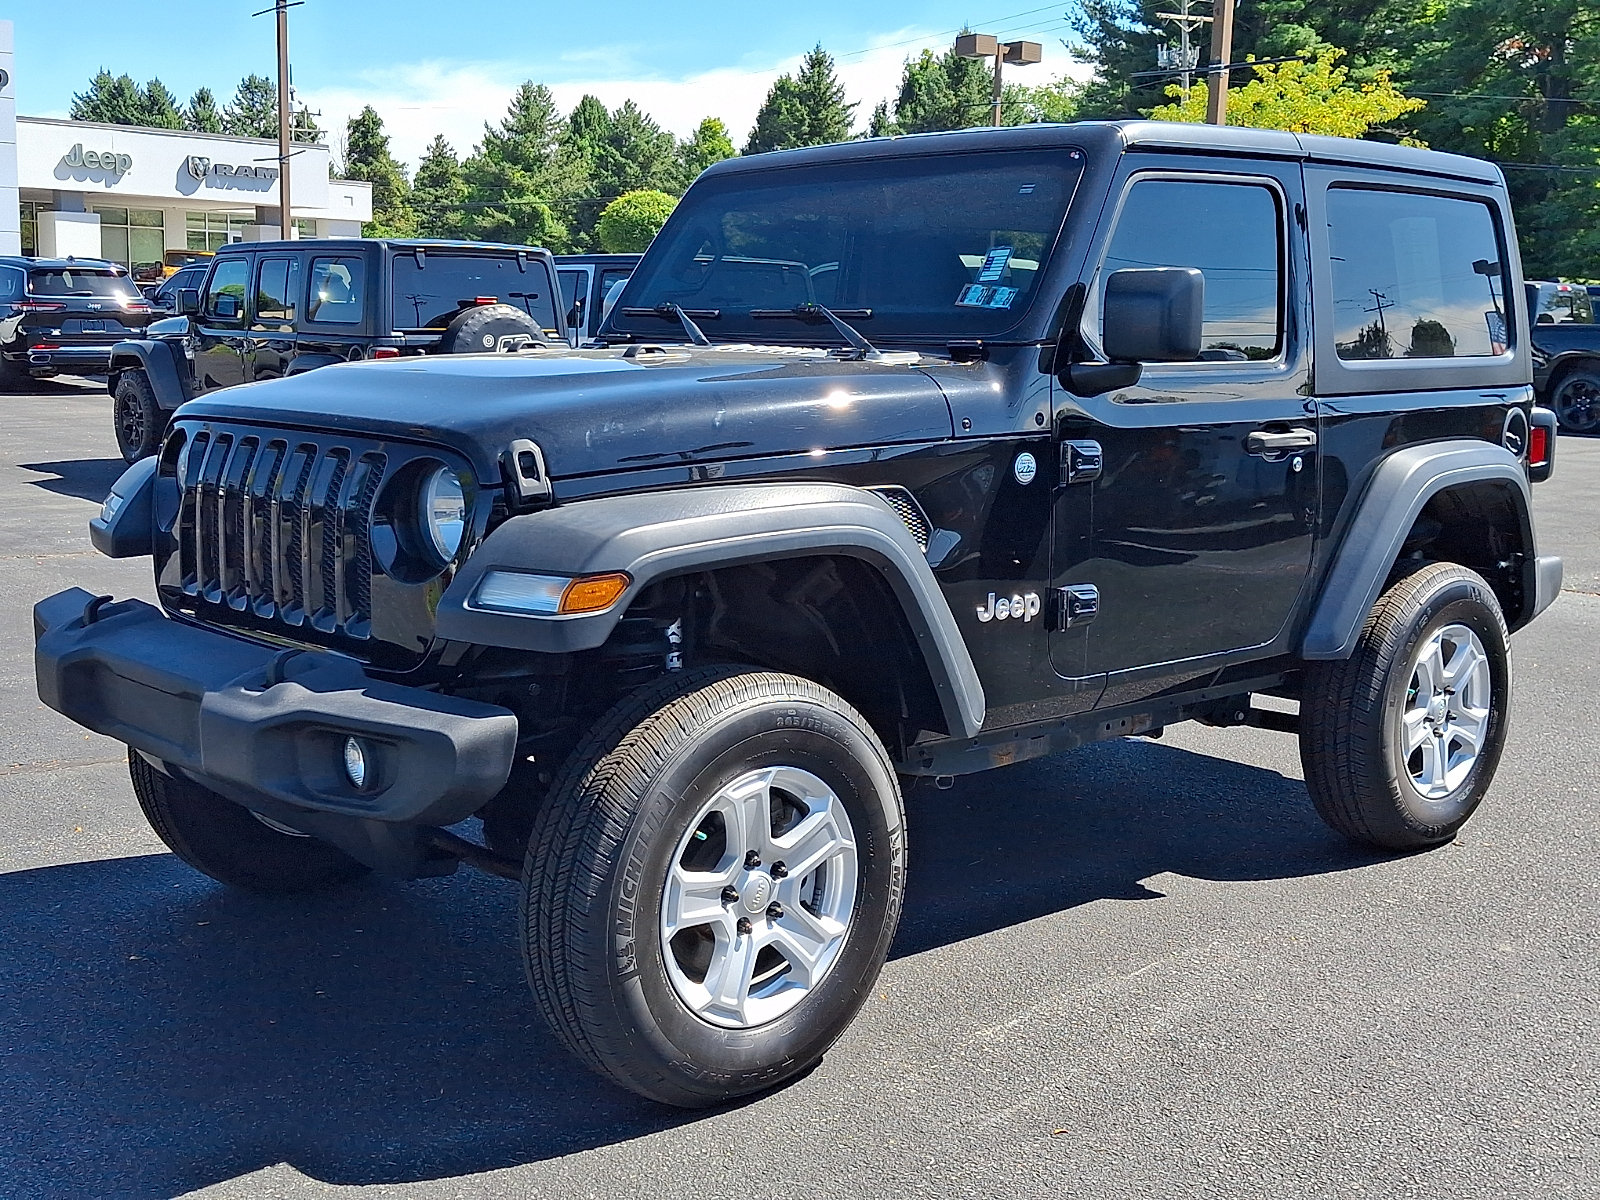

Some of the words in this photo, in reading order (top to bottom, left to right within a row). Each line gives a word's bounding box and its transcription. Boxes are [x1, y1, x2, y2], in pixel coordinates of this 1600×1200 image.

[65, 144, 132, 176] Jeep
[214, 164, 279, 179] RAM
[976, 592, 1040, 623] Jeep
[616, 791, 676, 936] MICHELIN
